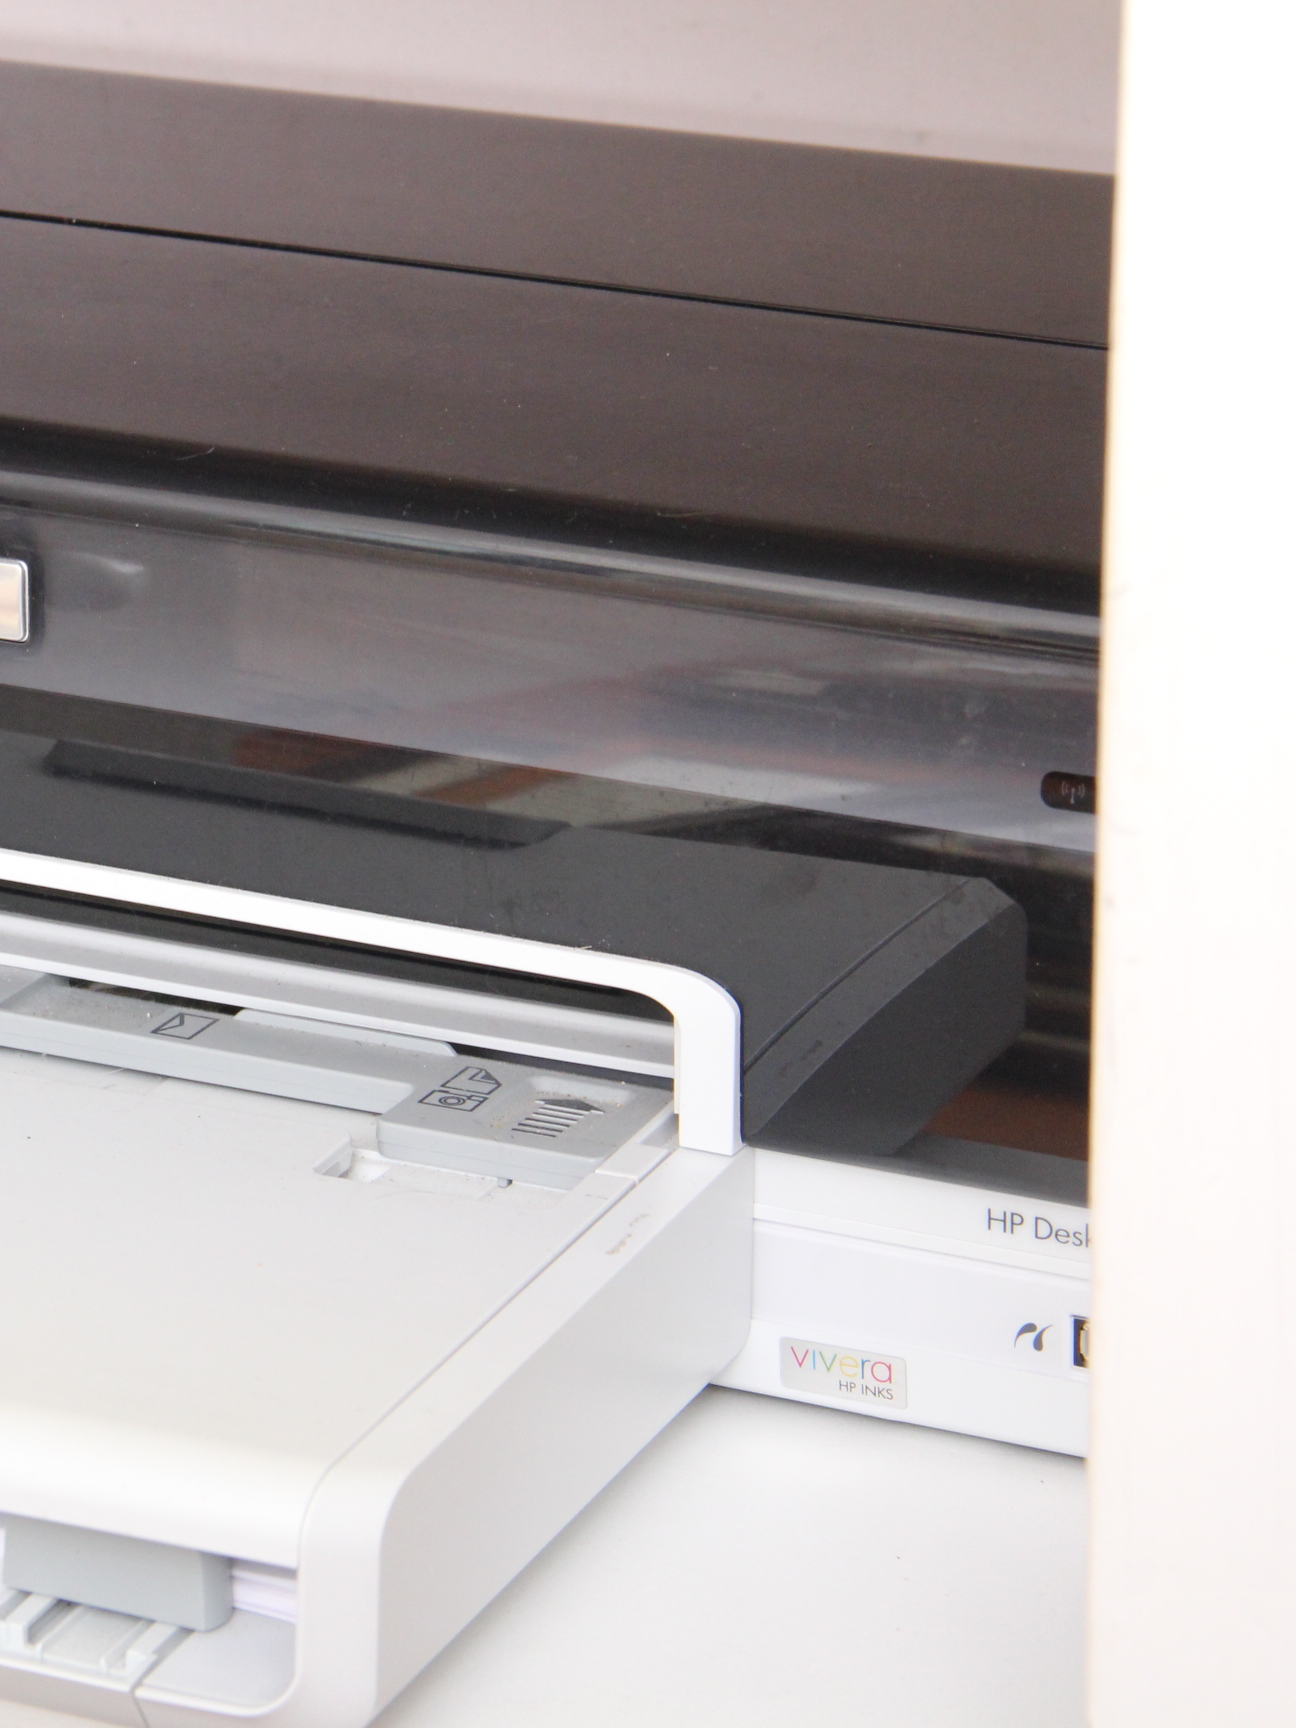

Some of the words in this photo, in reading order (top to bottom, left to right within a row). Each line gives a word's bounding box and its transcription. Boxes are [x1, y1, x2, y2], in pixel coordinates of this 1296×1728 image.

[987, 1207, 1025, 1234] HP
[838, 1379, 857, 1393] HP
[861, 1383, 894, 1401] INKS
